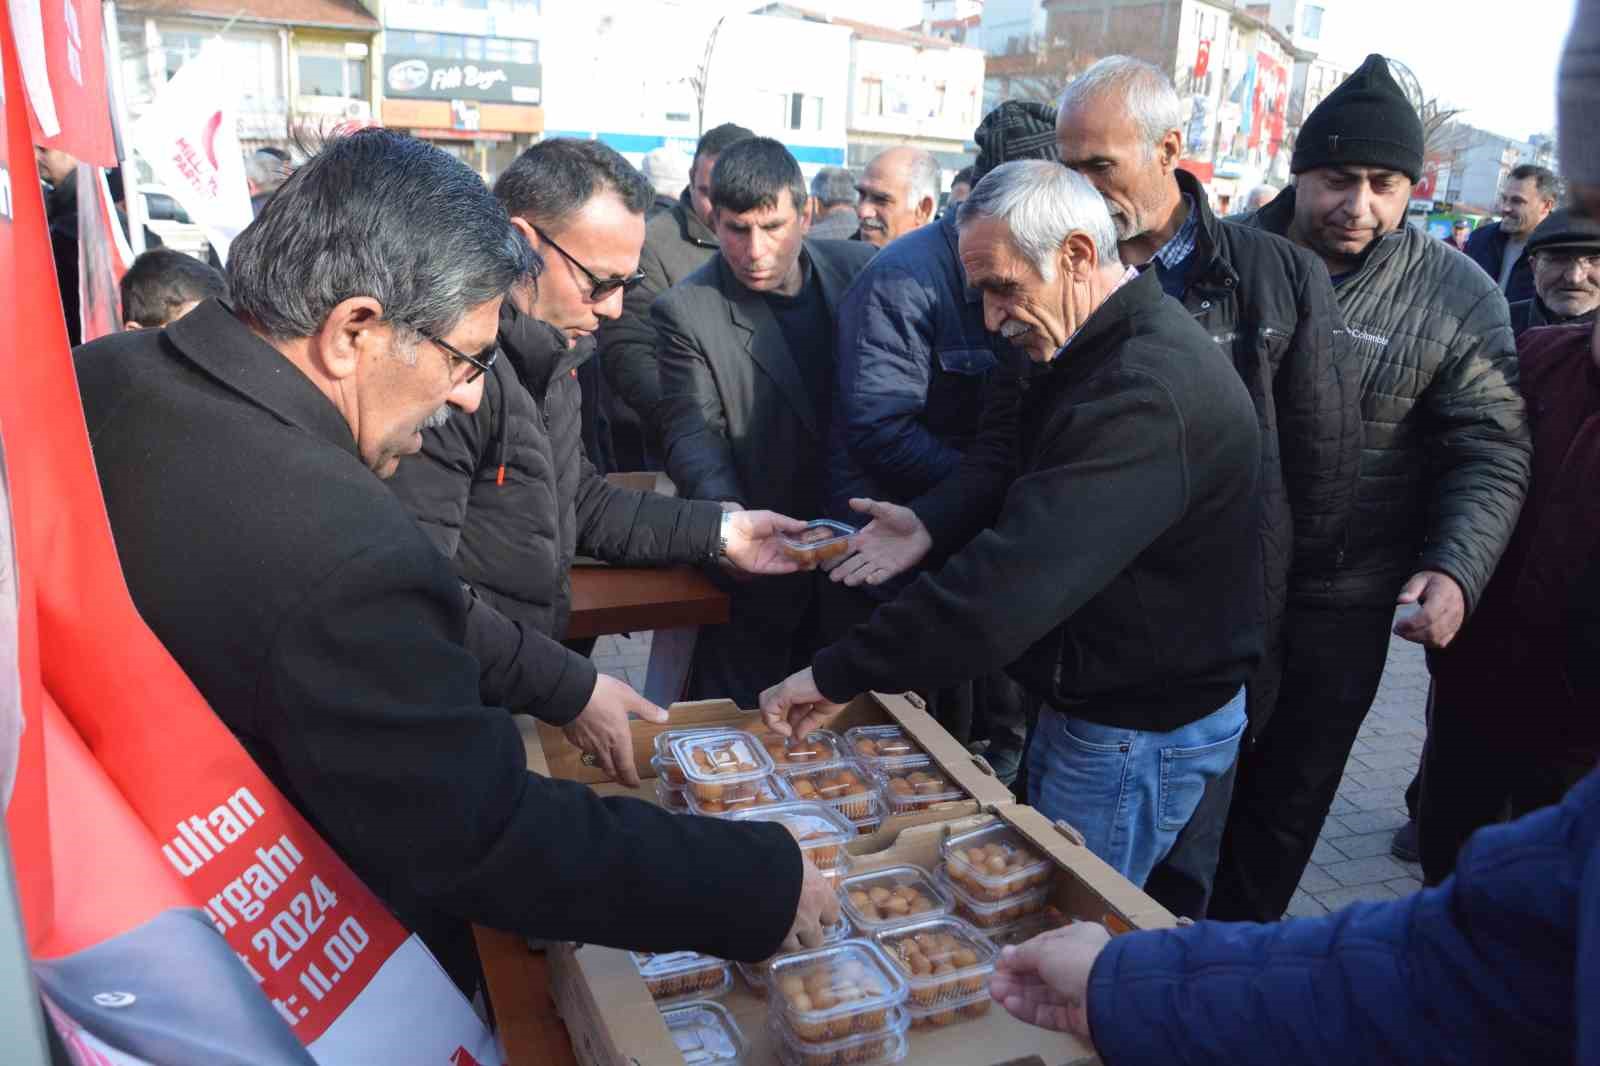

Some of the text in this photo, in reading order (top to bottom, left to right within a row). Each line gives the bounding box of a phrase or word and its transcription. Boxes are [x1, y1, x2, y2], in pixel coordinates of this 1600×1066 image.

[161, 786, 265, 877] ultan
[202, 834, 304, 935] ergahı
[251, 874, 338, 971] 2024
[299, 915, 369, 1001] 11.00
